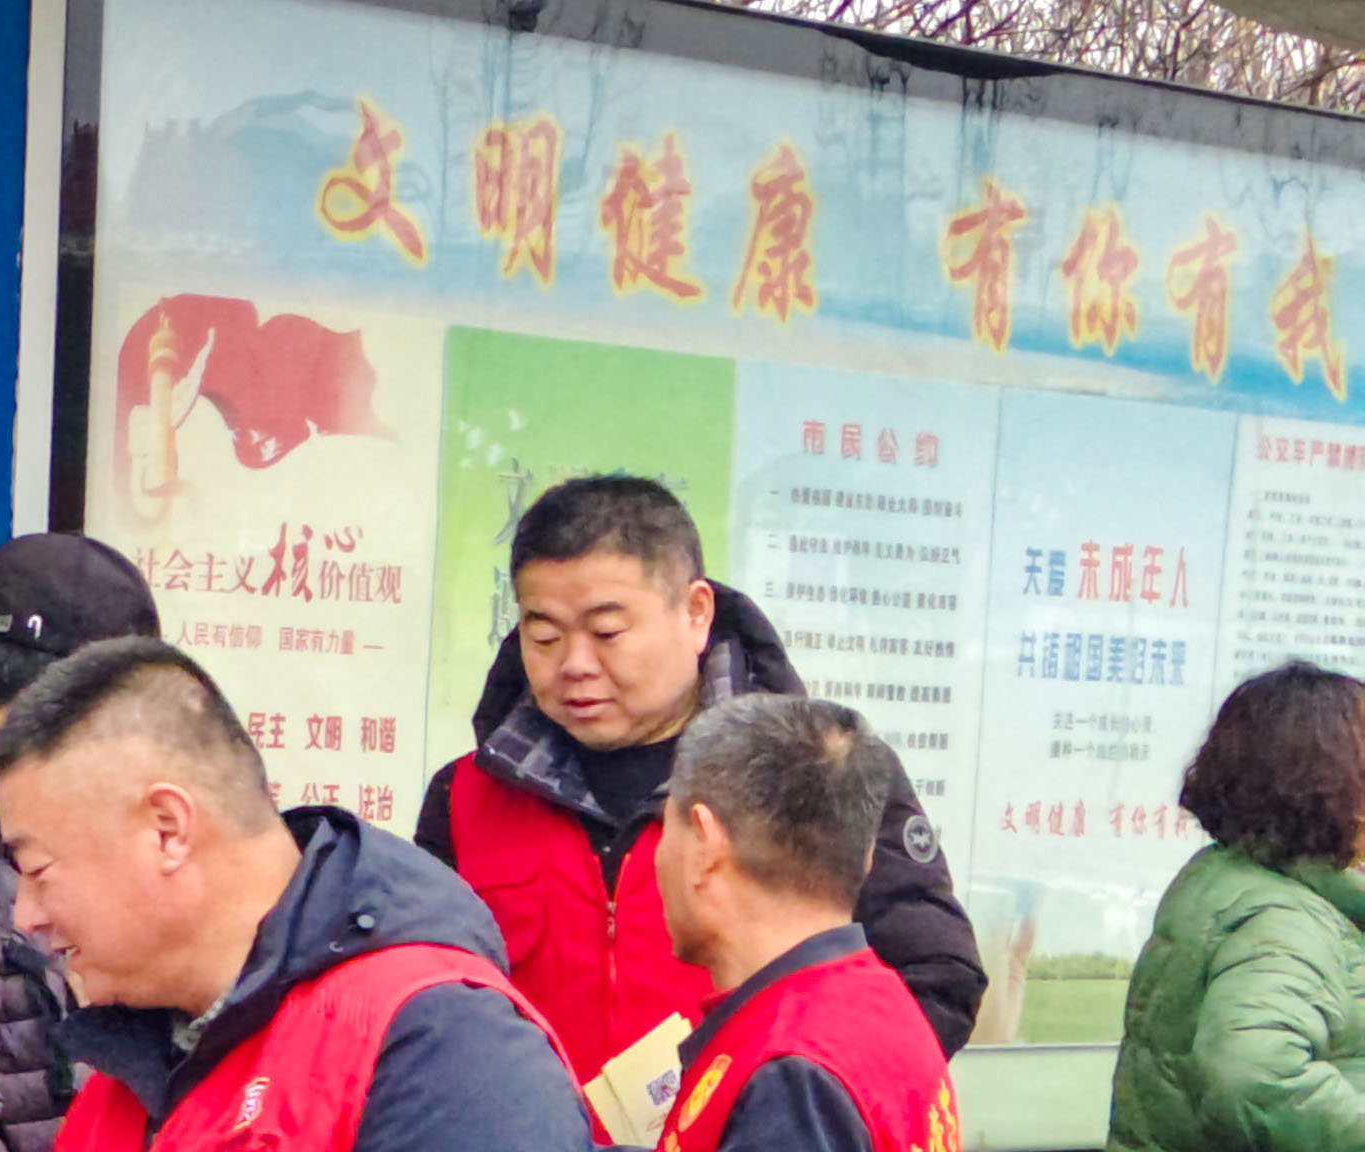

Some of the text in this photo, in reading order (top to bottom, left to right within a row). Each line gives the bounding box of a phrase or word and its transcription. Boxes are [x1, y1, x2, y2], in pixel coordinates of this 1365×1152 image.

[316, 95, 1347, 401] 文明健康 有你有我
[802, 420, 939, 468] 市民公约
[177, 620, 263, 649] 人民有信仰
[304, 713, 343, 751] 文明
[360, 716, 397, 754] 和谐
